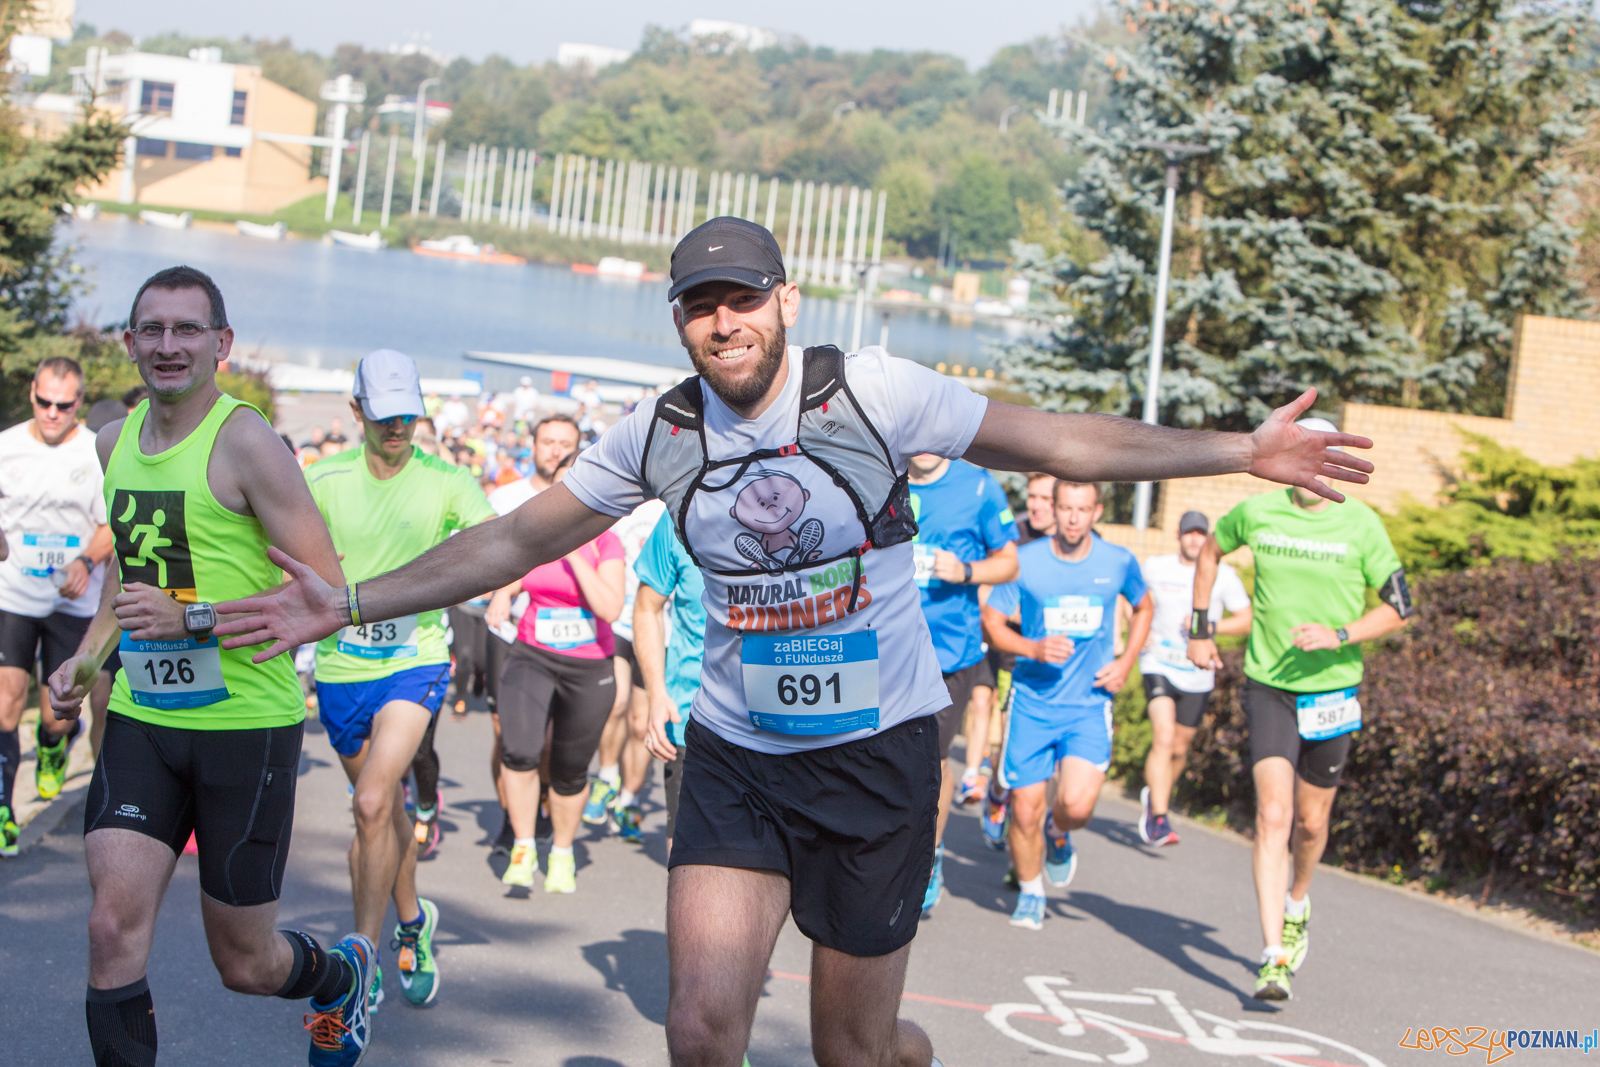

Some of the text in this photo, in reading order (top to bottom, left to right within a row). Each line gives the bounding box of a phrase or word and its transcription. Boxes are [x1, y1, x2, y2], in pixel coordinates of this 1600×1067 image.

[38, 551, 65, 564] 188
[727, 578, 807, 606] NATURAL
[1061, 612, 1089, 625] 544
[356, 622, 397, 641] 453
[552, 623, 581, 638] 613
[145, 641, 189, 651] FUNdusze
[773, 637, 844, 653] zaBIEGaj
[774, 653, 844, 664] o FUNdusze
[144, 657, 195, 686] 126
[777, 672, 842, 706] 691
[1318, 707, 1345, 726] 587
